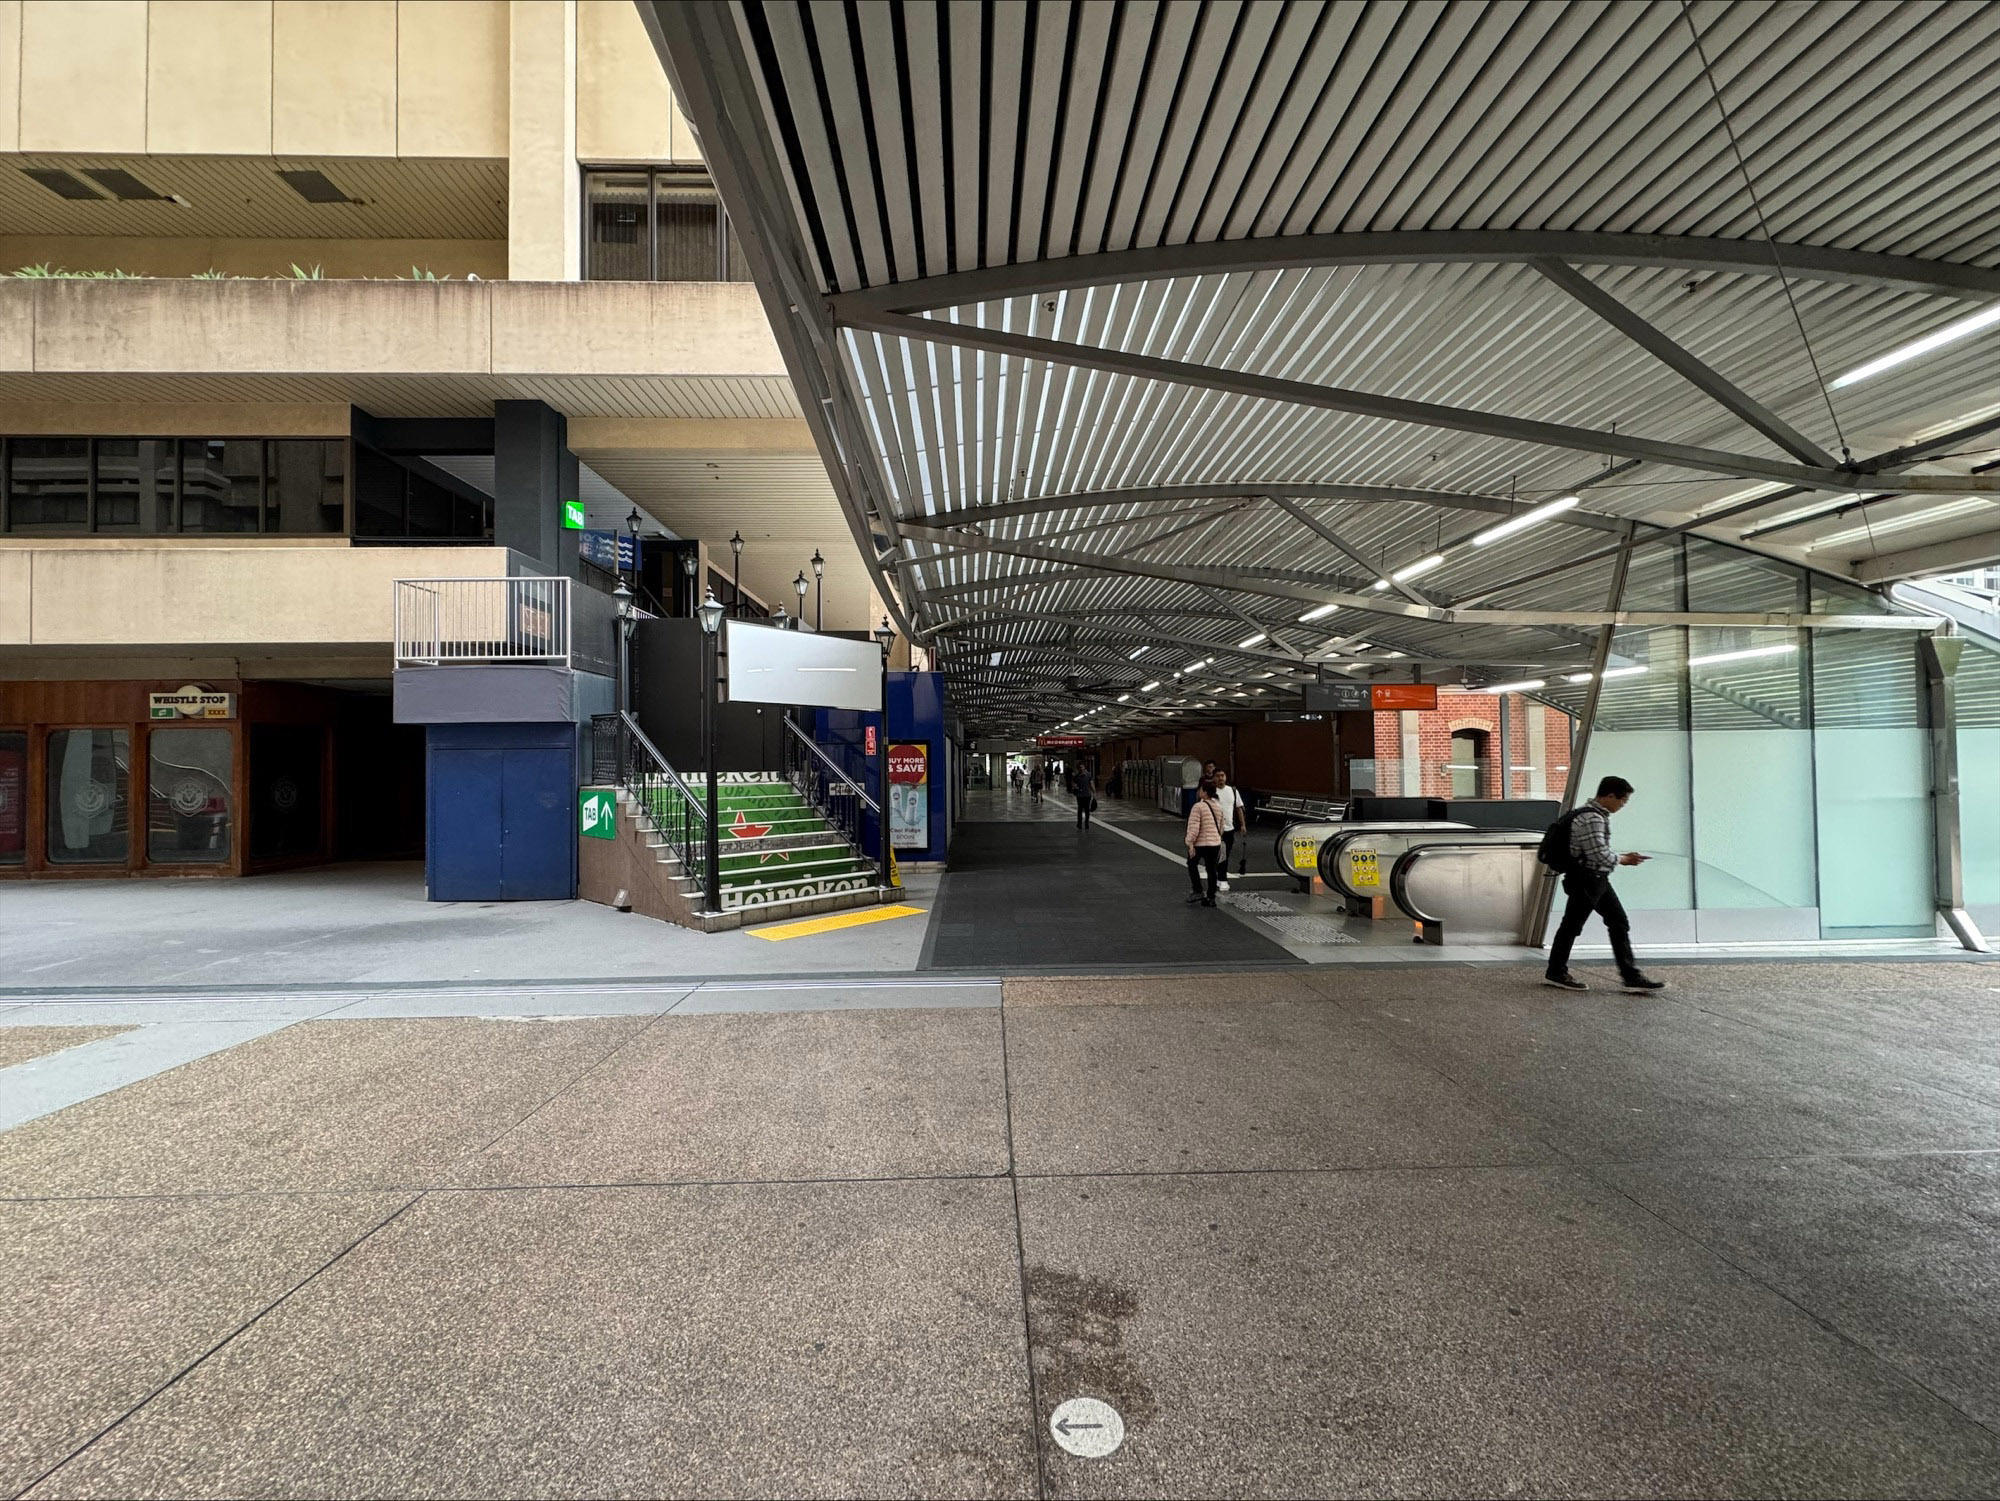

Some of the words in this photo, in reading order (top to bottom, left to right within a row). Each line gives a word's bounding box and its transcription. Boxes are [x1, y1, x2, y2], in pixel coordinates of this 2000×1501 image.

[567, 505, 584, 526] TAB
[153, 696, 198, 704] WHISTLE
[199, 696, 226, 704] STOP
[896, 764, 925, 773] SAVE
[584, 807, 597, 821] TAB
